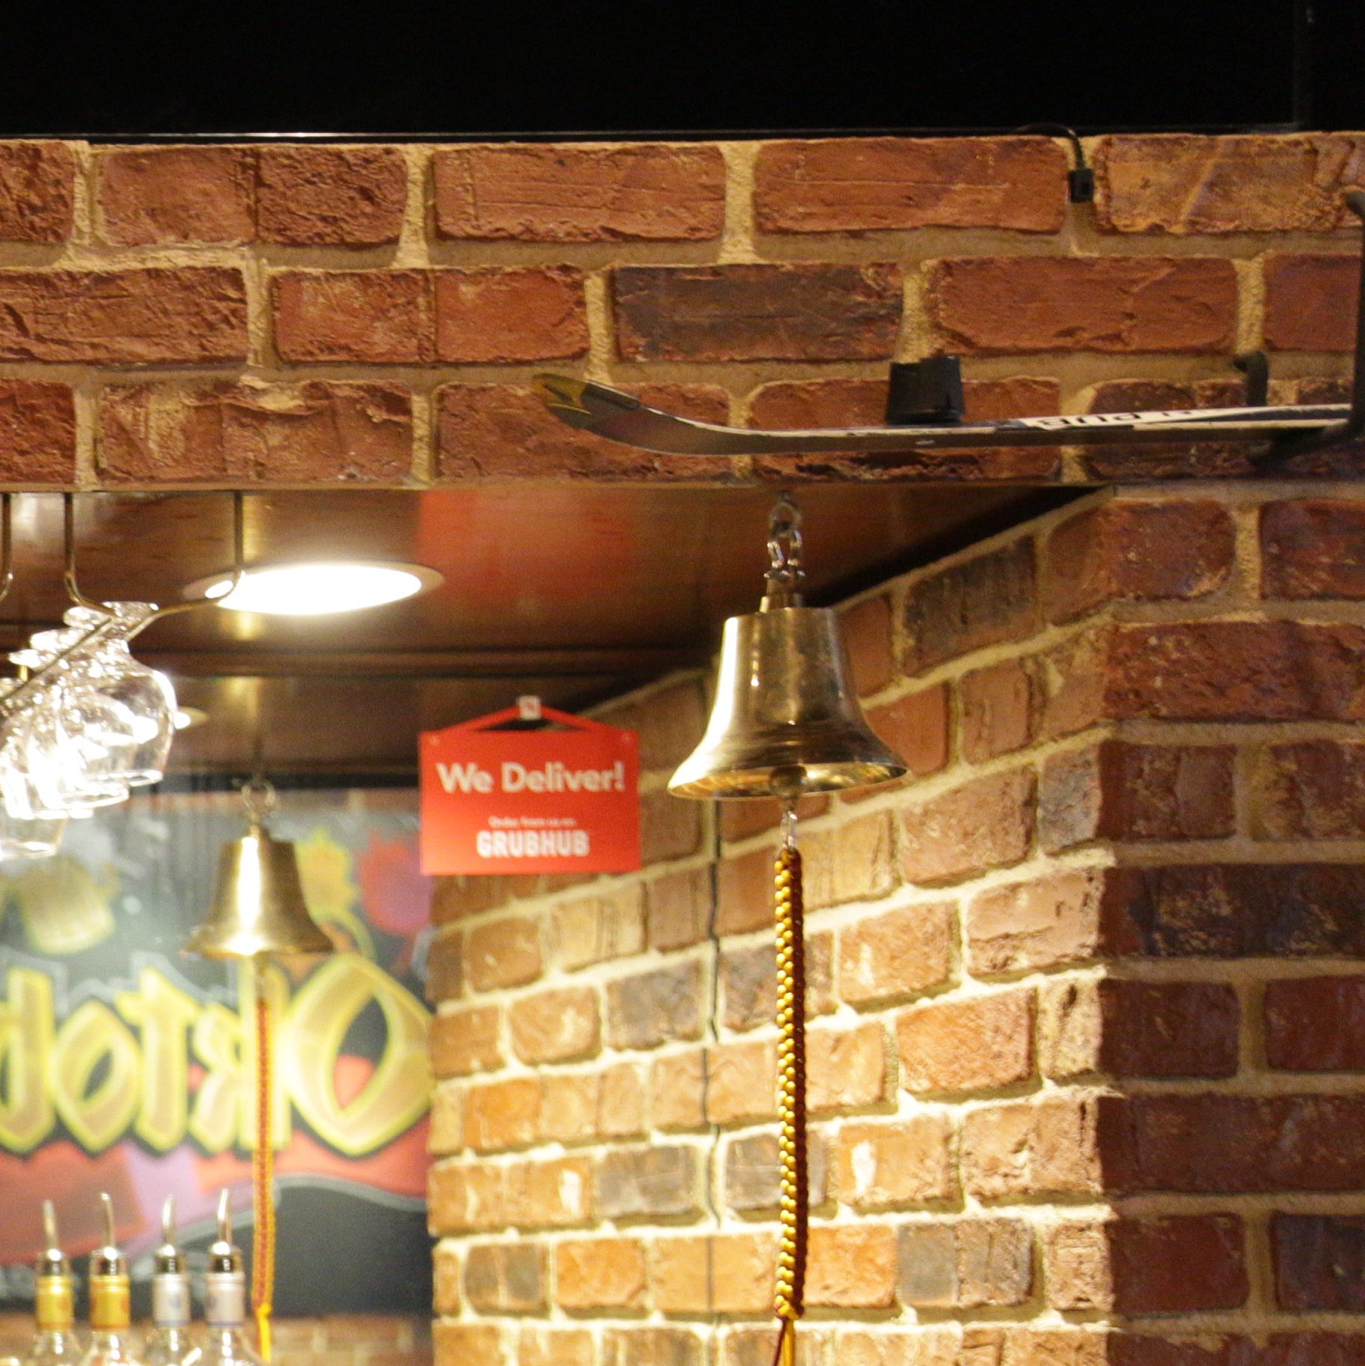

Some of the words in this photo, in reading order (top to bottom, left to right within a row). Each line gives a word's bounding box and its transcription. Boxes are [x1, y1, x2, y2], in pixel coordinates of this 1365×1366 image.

[435, 761, 494, 794] We
[500, 760, 626, 794] Deliver!
[476, 829, 590, 859] GRUBHUB
